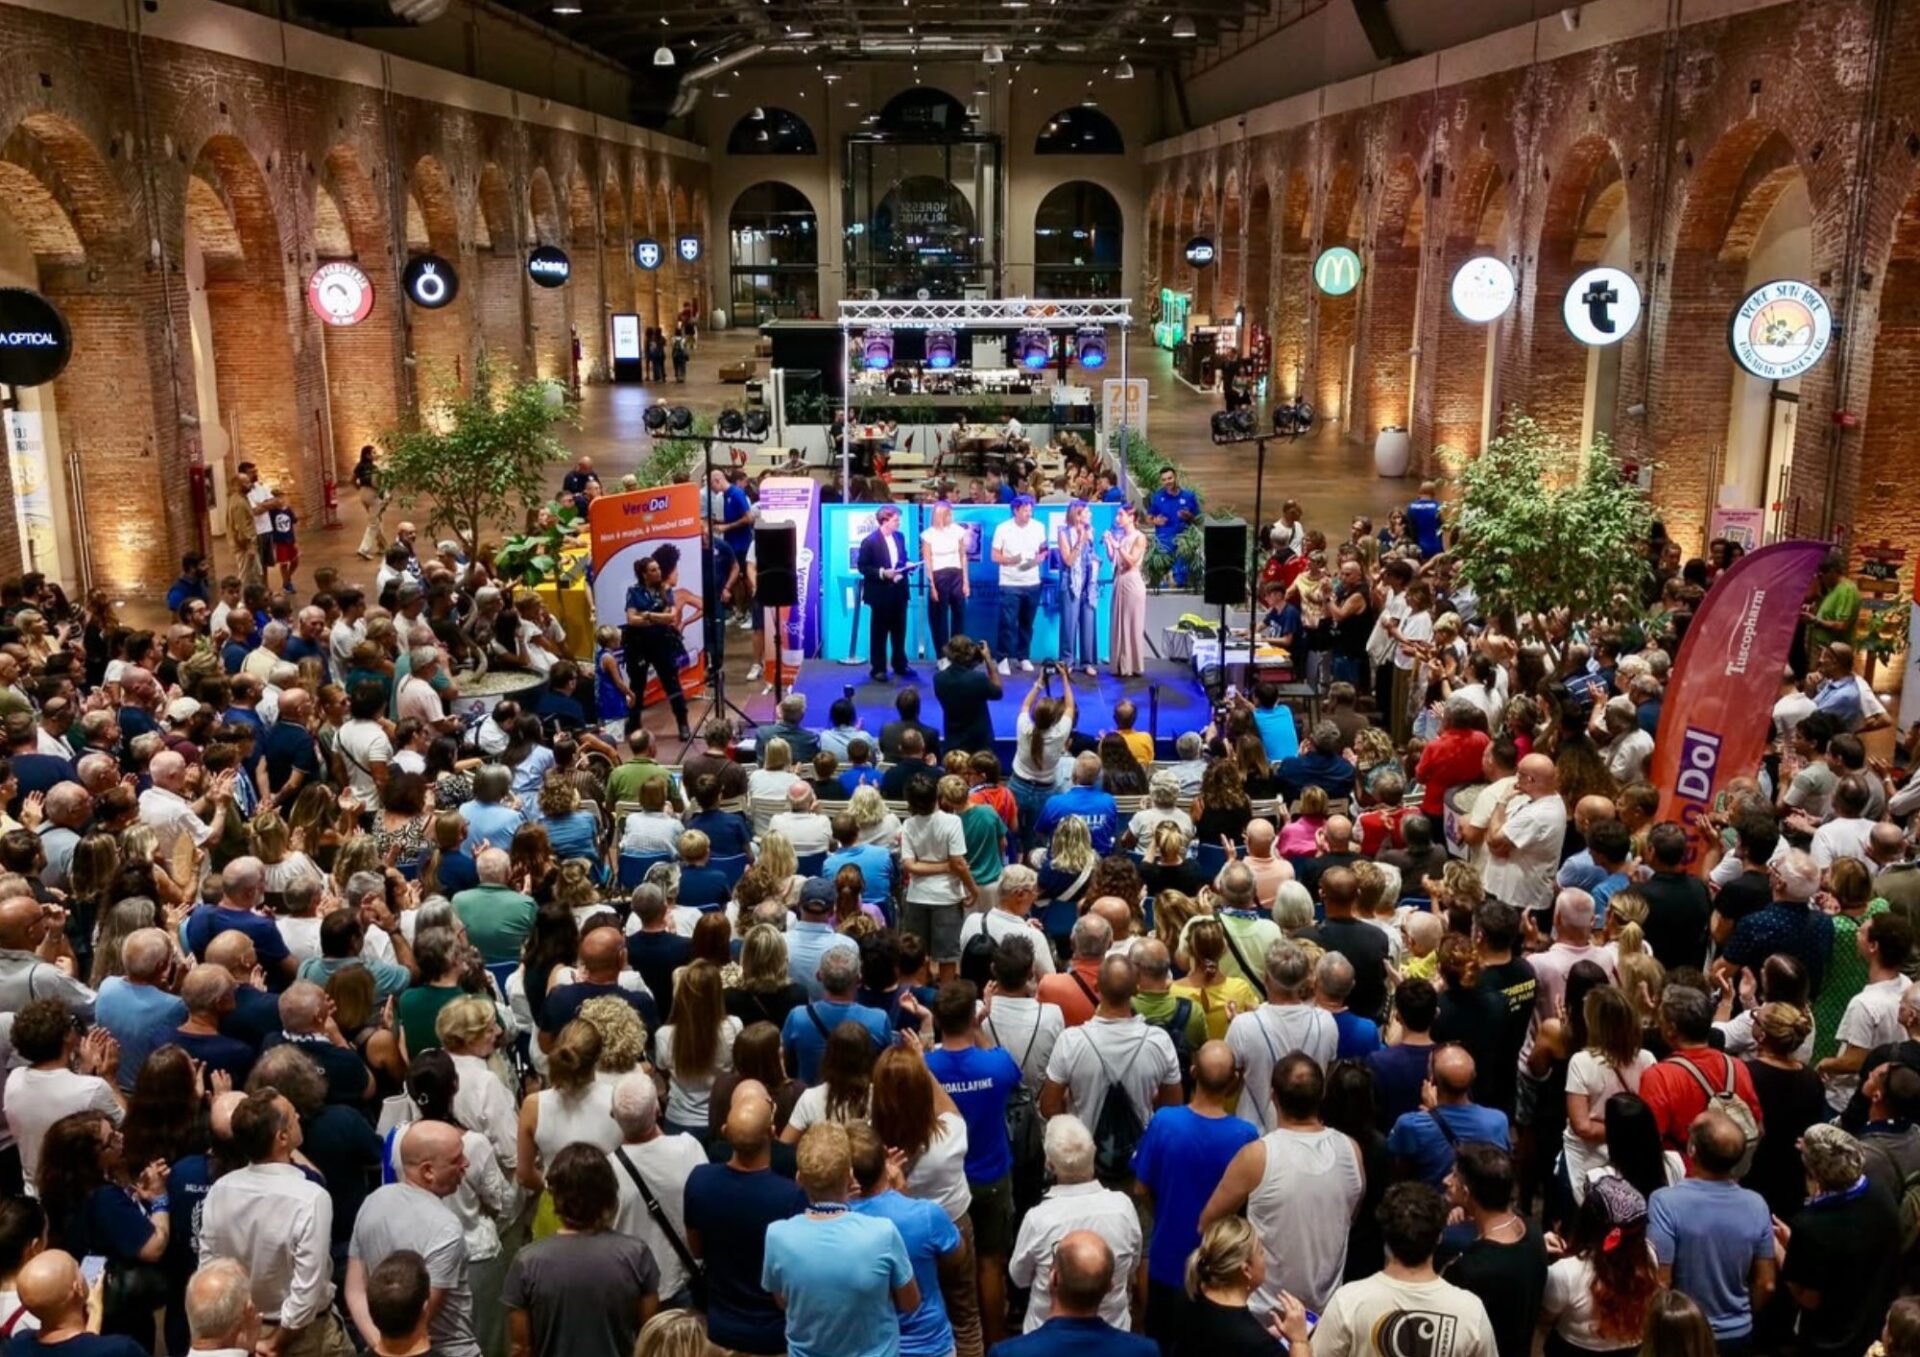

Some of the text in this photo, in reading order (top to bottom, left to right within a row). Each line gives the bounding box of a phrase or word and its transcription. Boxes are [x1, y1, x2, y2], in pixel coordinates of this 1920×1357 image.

[9, 331, 58, 345] OPTICAL
[623, 496, 669, 516] VeroDol
[1725, 590, 1766, 676] Tuscopharm
